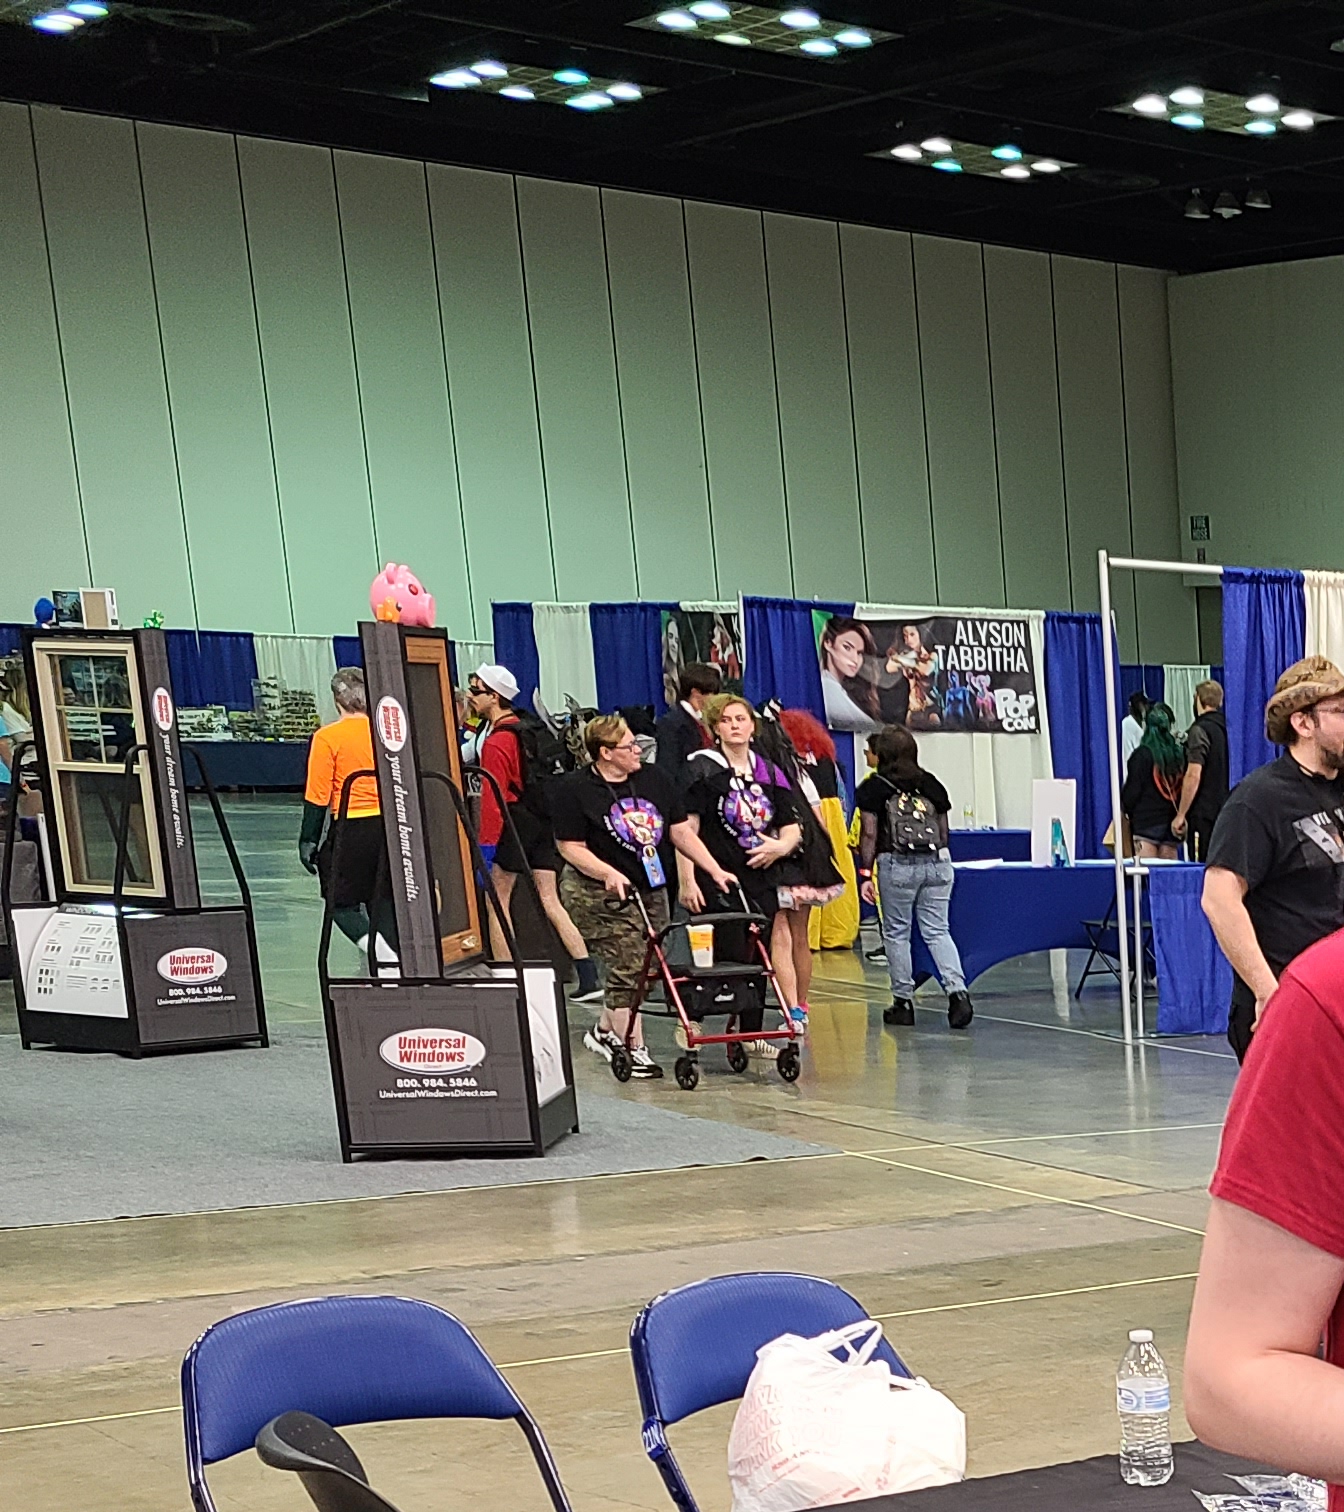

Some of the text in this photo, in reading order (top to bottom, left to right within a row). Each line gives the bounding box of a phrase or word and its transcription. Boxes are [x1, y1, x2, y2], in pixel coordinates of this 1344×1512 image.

[955, 620, 1026, 647] ALYSON
[935, 645, 1029, 673] TABBITHA
[994, 689, 1035, 720] POP
[1002, 716, 1036, 731] CON
[159, 733, 171, 757] your
[166, 757, 177, 787] dream
[170, 789, 180, 812] home
[385, 753, 420, 902] your dream home awaits.
[170, 953, 214, 965] Universal
[170, 965, 214, 976] Windows
[398, 1036, 466, 1049] Universal
[399, 1050, 465, 1063] Windows
[449, 1077, 477, 1087] 5846
[379, 1089, 498, 1098] UniversalWindowsDirect.com
